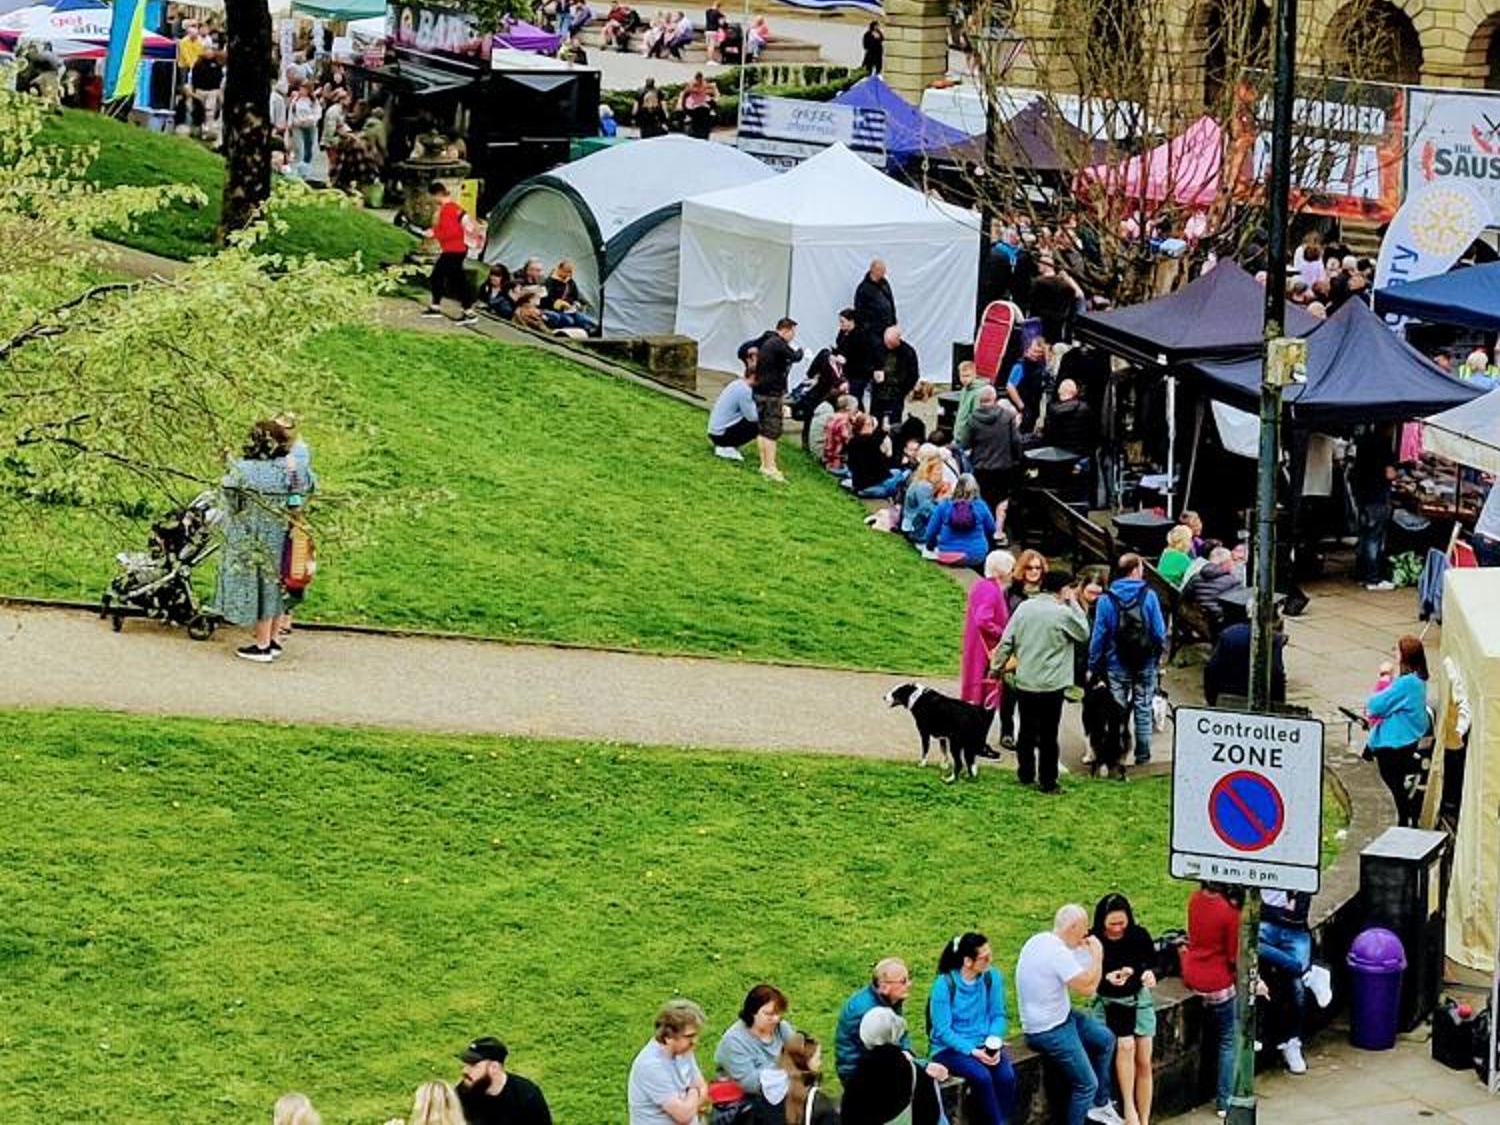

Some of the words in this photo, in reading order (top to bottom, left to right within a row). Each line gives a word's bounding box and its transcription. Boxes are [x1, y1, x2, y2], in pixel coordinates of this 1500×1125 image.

[1455, 143, 1472, 154] THE
[1197, 718, 1301, 744] Controlled
[1211, 742, 1284, 769] ZONE
